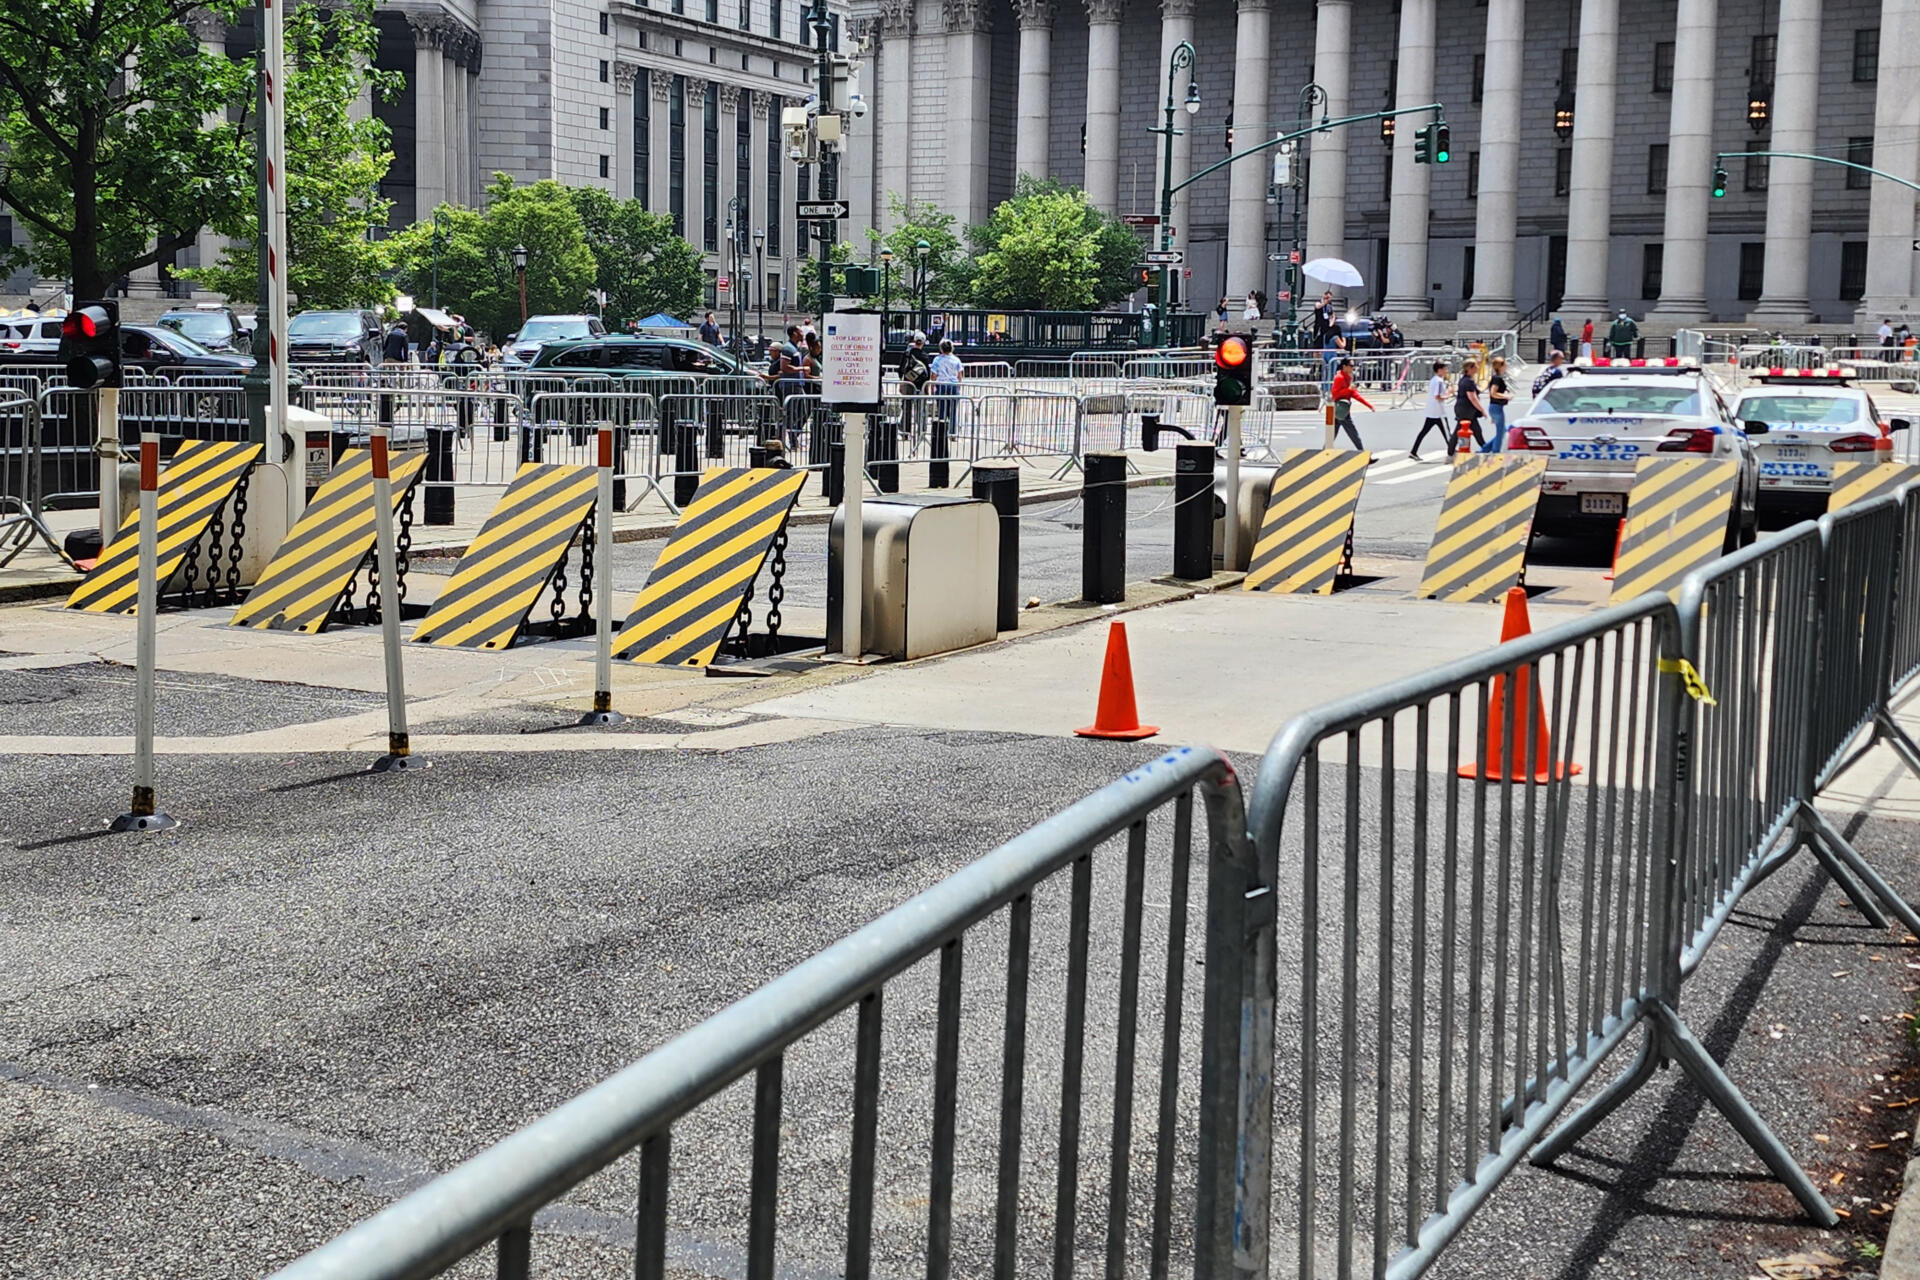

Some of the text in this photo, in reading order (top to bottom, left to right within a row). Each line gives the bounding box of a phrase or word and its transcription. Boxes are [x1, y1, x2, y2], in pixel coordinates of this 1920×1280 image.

[803, 206, 841, 214] ONE WAY
[1090, 315, 1123, 325] Subway
[1570, 444, 1640, 453] NYPD
[1558, 452, 1651, 461] POLIC
[1762, 462, 1819, 470] NYPD
